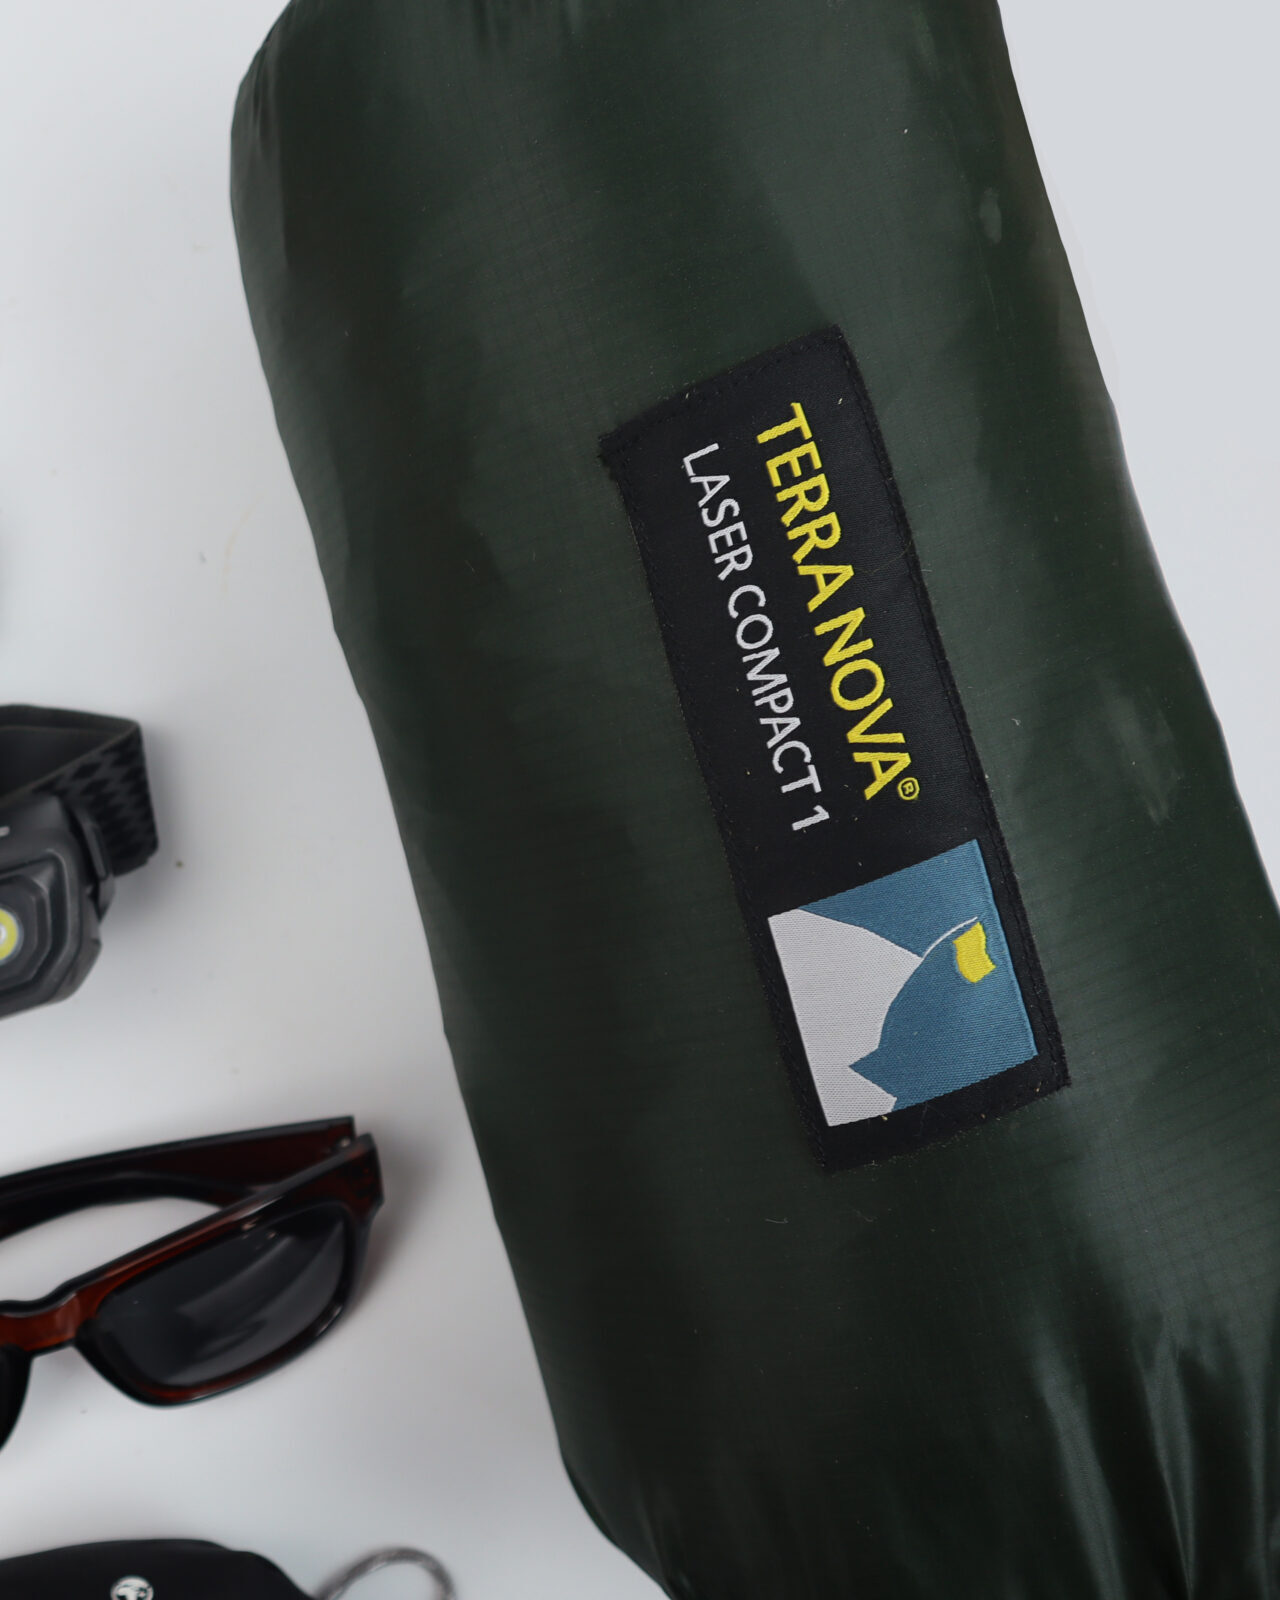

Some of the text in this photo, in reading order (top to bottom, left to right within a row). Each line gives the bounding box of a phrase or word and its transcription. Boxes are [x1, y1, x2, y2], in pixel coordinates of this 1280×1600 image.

[682, 443, 830, 831] LASER COMPACT 1
[756, 402, 854, 613] TERRA
